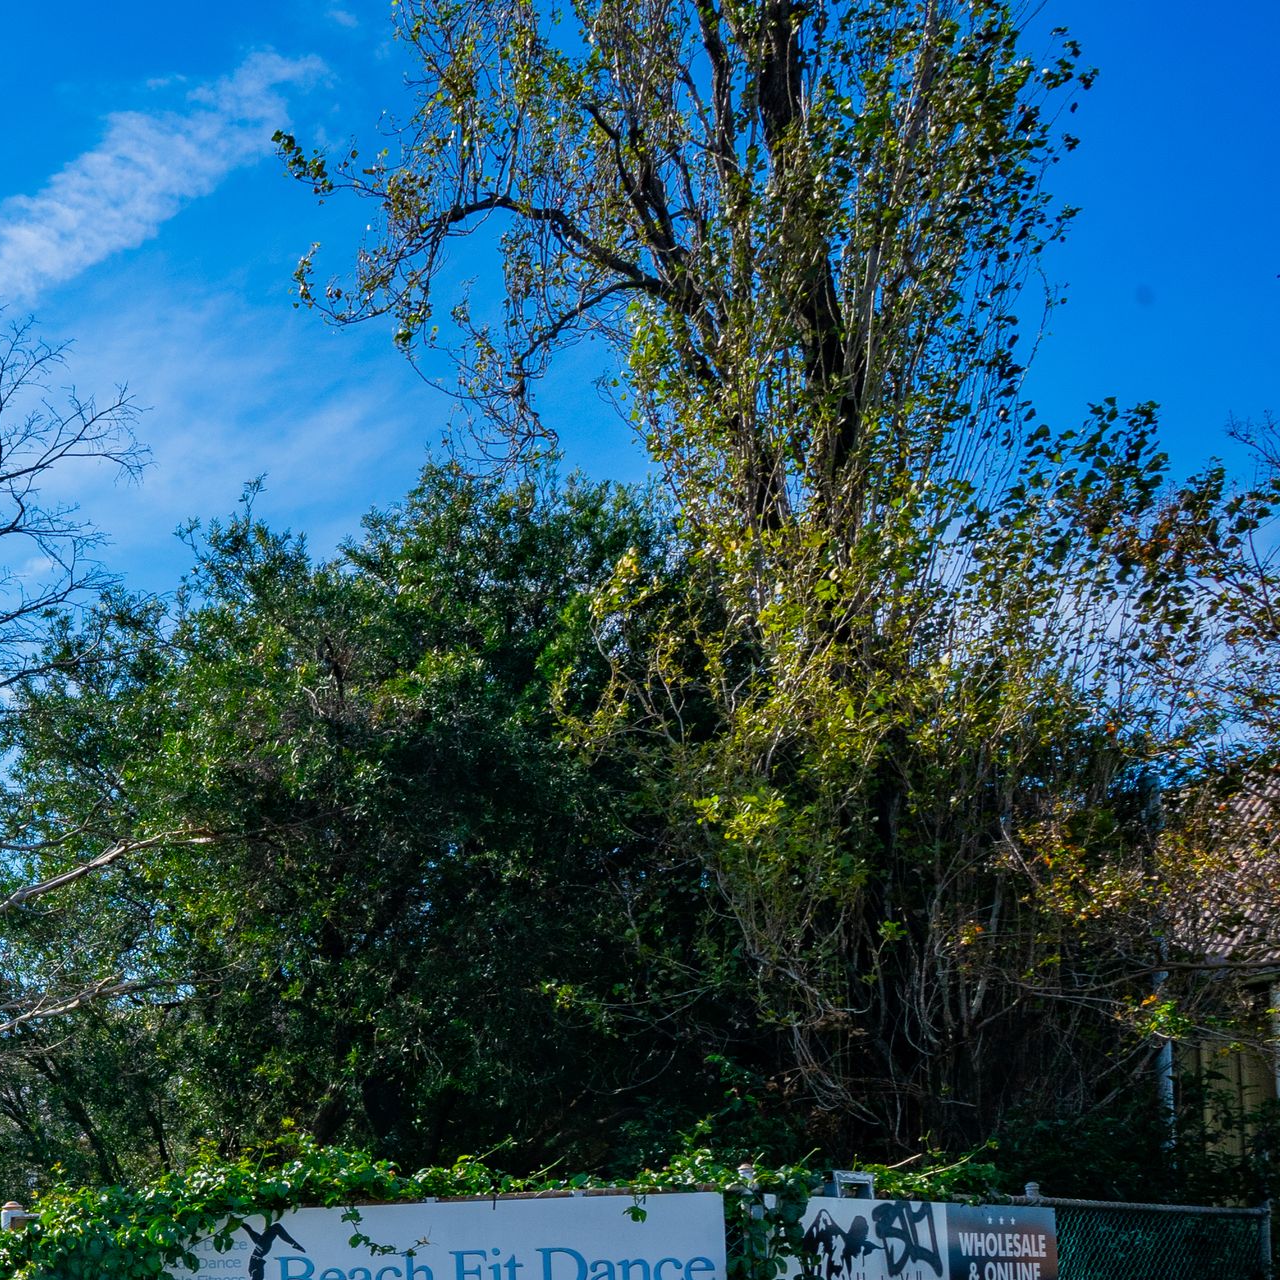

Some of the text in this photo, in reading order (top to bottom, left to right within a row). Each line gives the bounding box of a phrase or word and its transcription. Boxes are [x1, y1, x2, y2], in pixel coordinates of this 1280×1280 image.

[204, 1240, 248, 1250] Dce
[959, 1232, 1046, 1258] WHOLESALE
[199, 1258, 241, 1269] Dance
